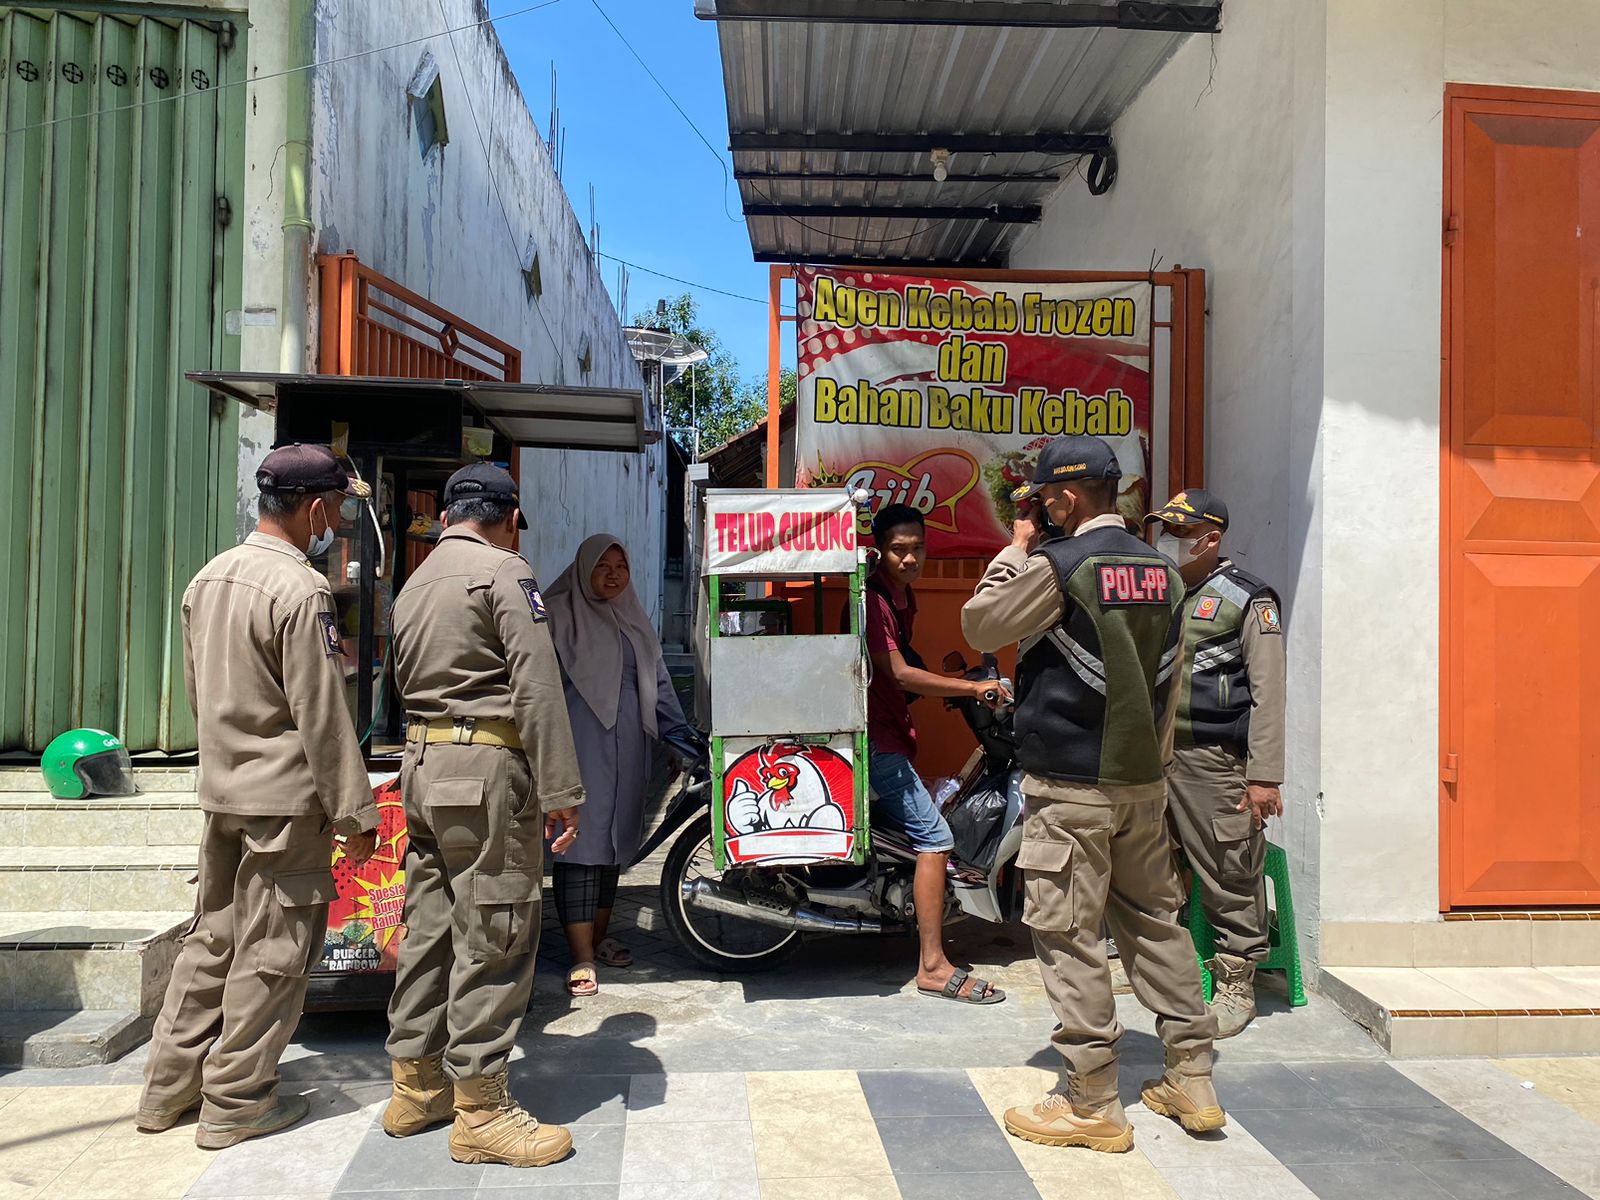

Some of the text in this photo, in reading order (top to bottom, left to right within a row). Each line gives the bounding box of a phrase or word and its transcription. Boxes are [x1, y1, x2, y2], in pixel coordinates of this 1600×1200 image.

[812, 276, 1136, 336] Agen Kebab Frozen
[937, 334, 1006, 384] dan
[813, 377, 1133, 436] Bahan Baku Kebab
[714, 511, 776, 553] TELUR
[778, 511, 855, 552] GULUNG
[1100, 567, 1168, 602] POL-PP
[328, 960, 379, 971] RAINBOW
[333, 948, 376, 960] BURGER
